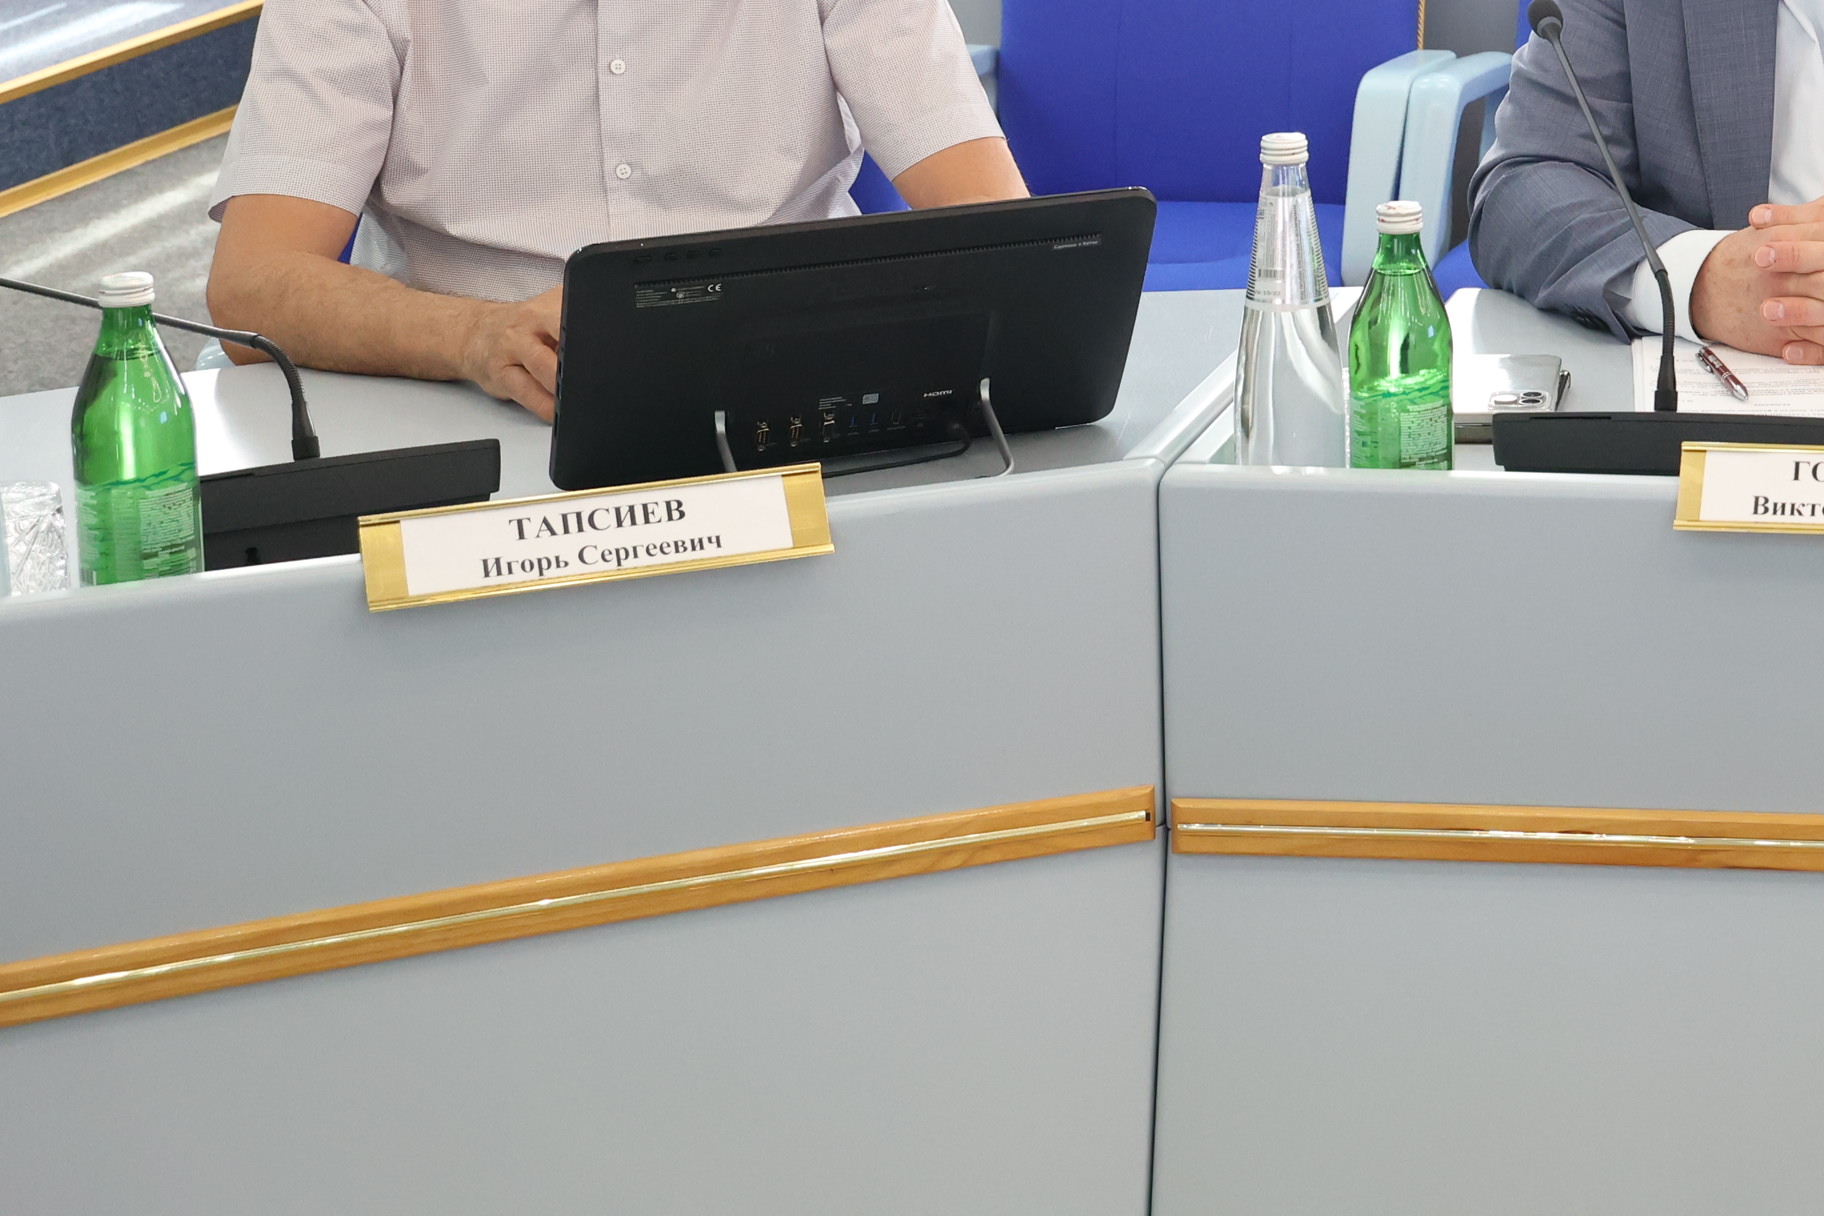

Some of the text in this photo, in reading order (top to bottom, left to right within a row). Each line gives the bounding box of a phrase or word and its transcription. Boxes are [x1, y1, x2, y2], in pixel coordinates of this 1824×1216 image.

[923, 389, 953, 398] HDMI
[508, 499, 687, 541] ТАПСИЕВ
[480, 533, 723, 579] Игорь Сергеевич
